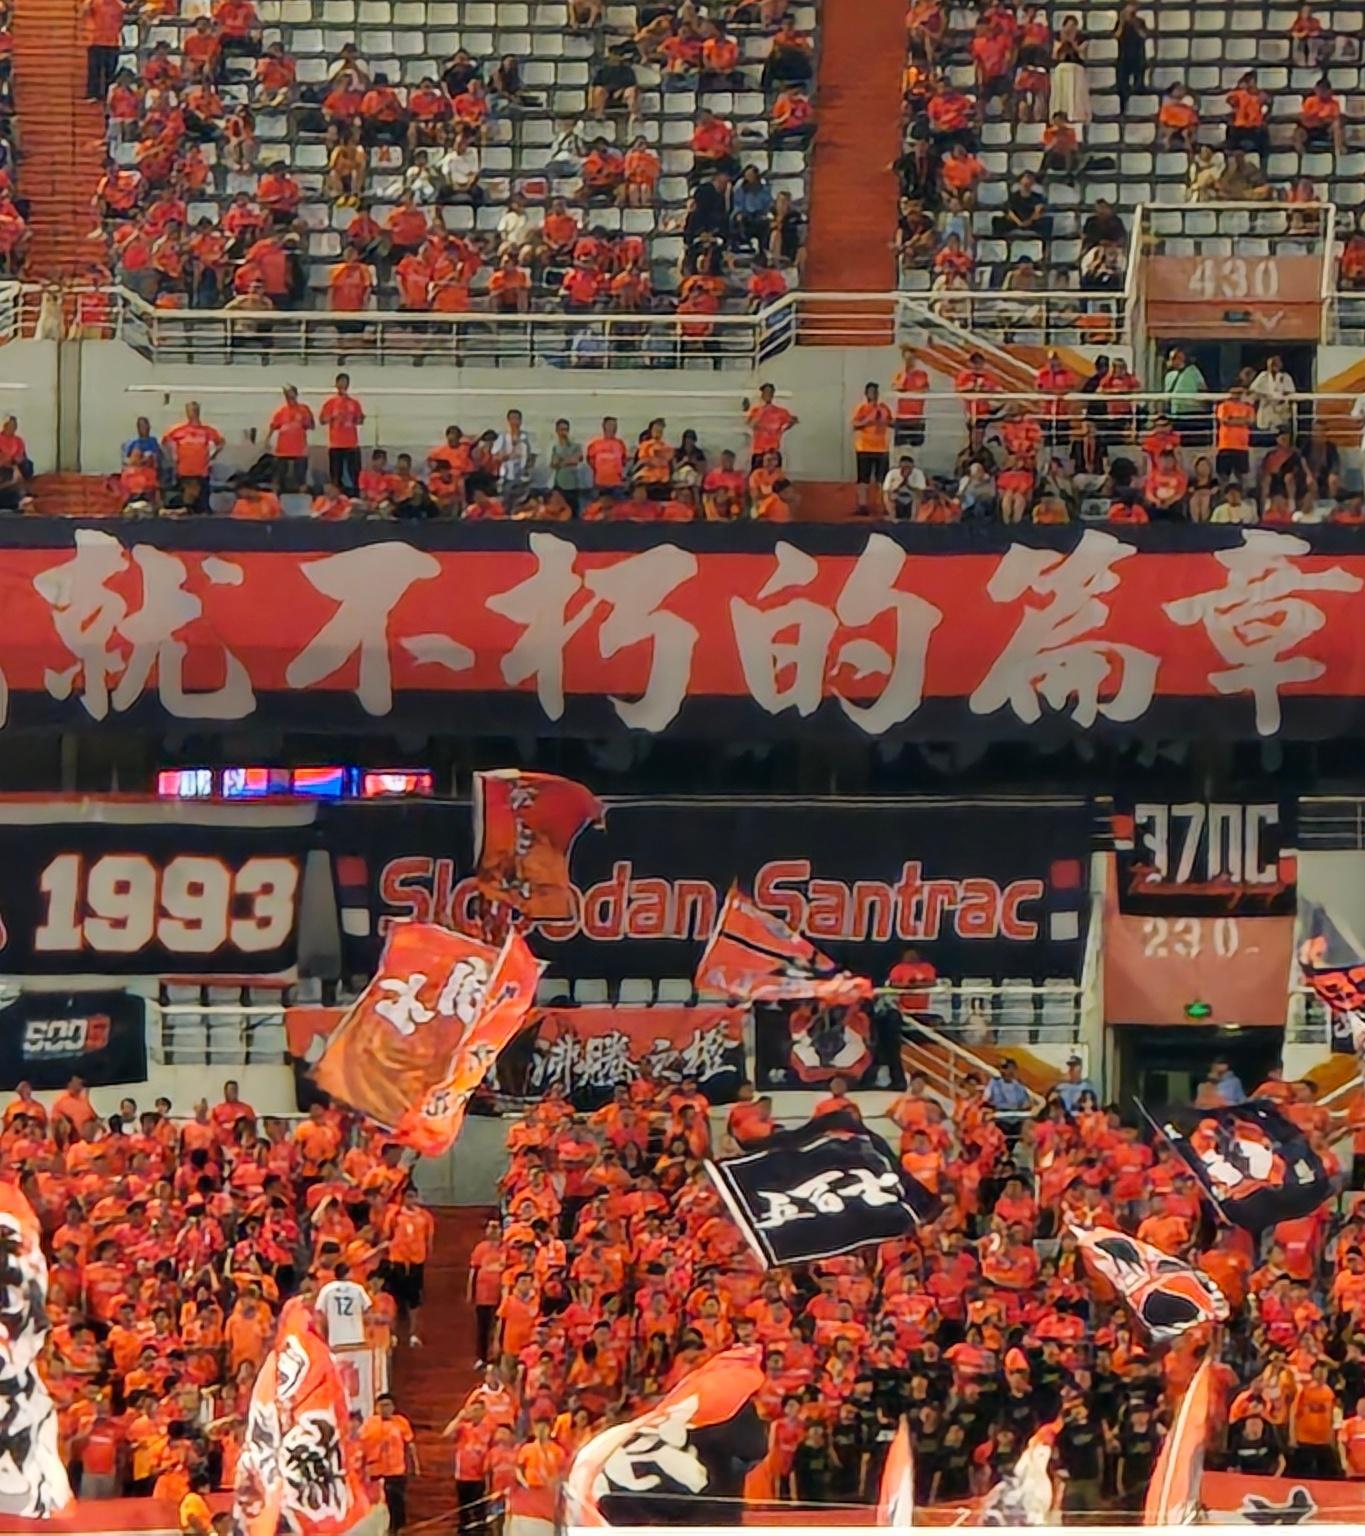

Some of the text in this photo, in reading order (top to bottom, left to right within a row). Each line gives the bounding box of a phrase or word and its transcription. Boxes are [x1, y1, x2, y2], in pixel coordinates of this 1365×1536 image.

[1188, 258, 1281, 298] 430
[0, 528, 1365, 737] 就不朽的篇章
[34, 852, 300, 954] 1993
[754, 858, 1045, 943] Santrac
[1143, 916, 1239, 958] 230
[334, 1296, 353, 1316] 12
